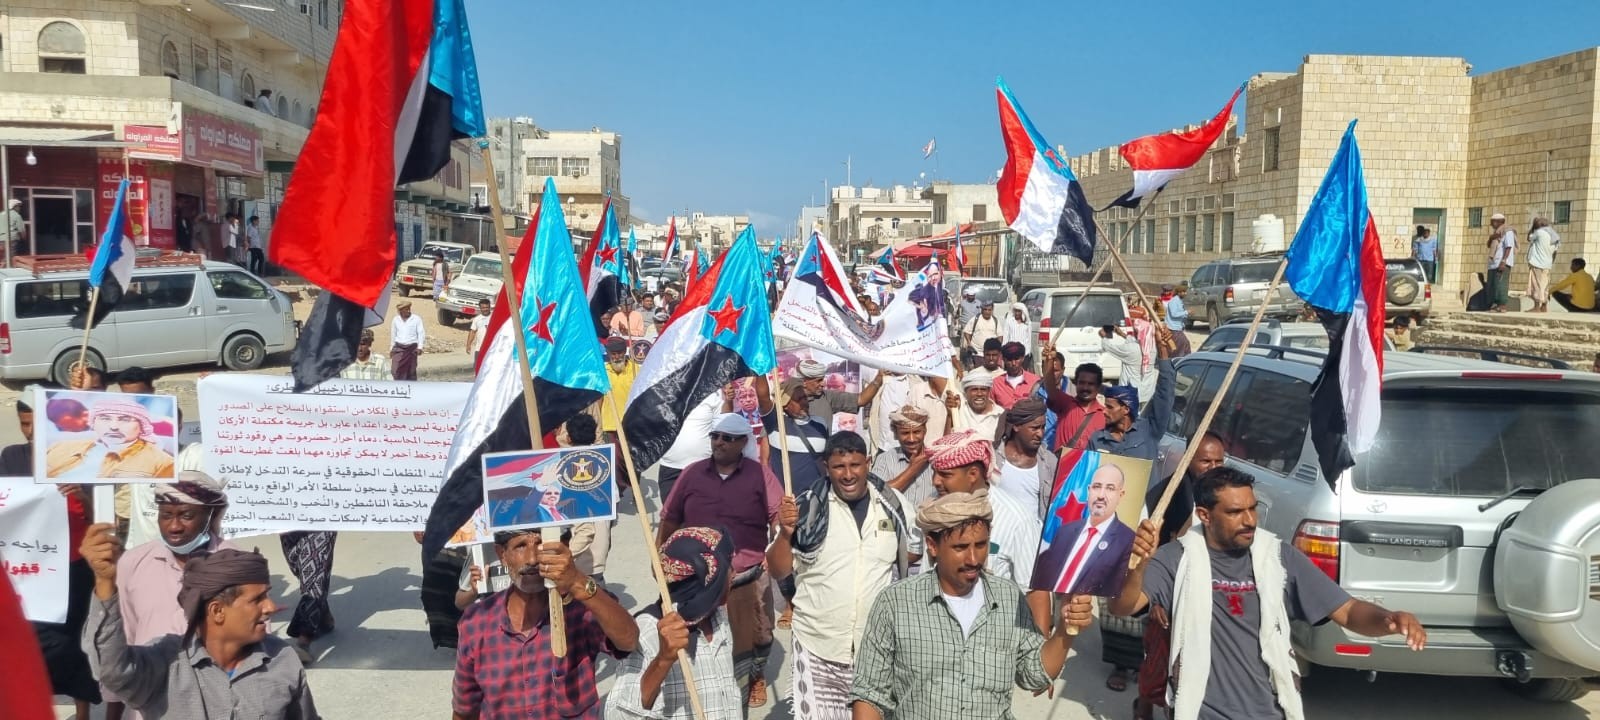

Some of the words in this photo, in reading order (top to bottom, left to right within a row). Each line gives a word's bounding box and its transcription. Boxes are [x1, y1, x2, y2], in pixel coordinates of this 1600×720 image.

[349, 384, 388, 396] محافظة
[392, 384, 411, 396] أبناء
[218, 401, 254, 411] الصدور
[256, 402, 274, 413] على
[276, 403, 312, 415] بالسلاح
[314, 404, 349, 415] استقواء
[352, 407, 365, 416] من
[367, 406, 388, 416] المكلا
[391, 406, 399, 418] في
[401, 407, 426, 417] حدث
[429, 408, 438, 417] ما
[440, 409, 450, 419] إن
[219, 414, 249, 426] الأركان
[252, 416, 284, 425] مكتملة
[286, 416, 315, 427] جريمة
[317, 419, 328, 428] بل
[354, 419, 380, 429] اعتداء
[383, 420, 407, 431] مجرد
[409, 421, 430, 432] ليس
[432, 422, 460, 433] لعارية
[217, 430, 243, 441] ثورتنا
[246, 432, 267, 443] وقود
[269, 434, 283, 445] هي
[286, 431, 331, 443] حضرموت
[332, 432, 356, 444] أحرار
[359, 434, 377, 444] دماء
[239, 445, 274, 456] غطرسة
[276, 446, 301, 457] بلغت
[303, 447, 324, 458] مهما
[326, 446, 351, 459] تجاوزه
[355, 448, 379, 459] يمكن
[381, 448, 388, 457] لا
[391, 448, 411, 459] أحمر
[414, 450, 436, 461] وخط
[218, 463, 252, 476] لإطلاق
[255, 465, 290, 476] التدخل
[293, 465, 321, 477] سرعة
[324, 465, 332, 480] في
[336, 466, 380, 479] الحقوقية
[383, 467, 426, 477] المنظمات
[243, 480, 259, 491] وما
[296, 480, 319, 493] الأمر
[322, 482, 352, 492] سلطة
[354, 483, 387, 493] سجون
[390, 482, 398, 496] في
[401, 483, 439, 495] لمعتقلين
[235, 496, 298, 509] والشخصيات
[342, 499, 390, 510] الناشطين
[393, 498, 428, 509] ملاحقة
[258, 511, 295, 523] الشعب
[297, 513, 326, 524] صوت
[329, 513, 368, 525] لإسكات
[11, 540, 58, 553] يواجه
